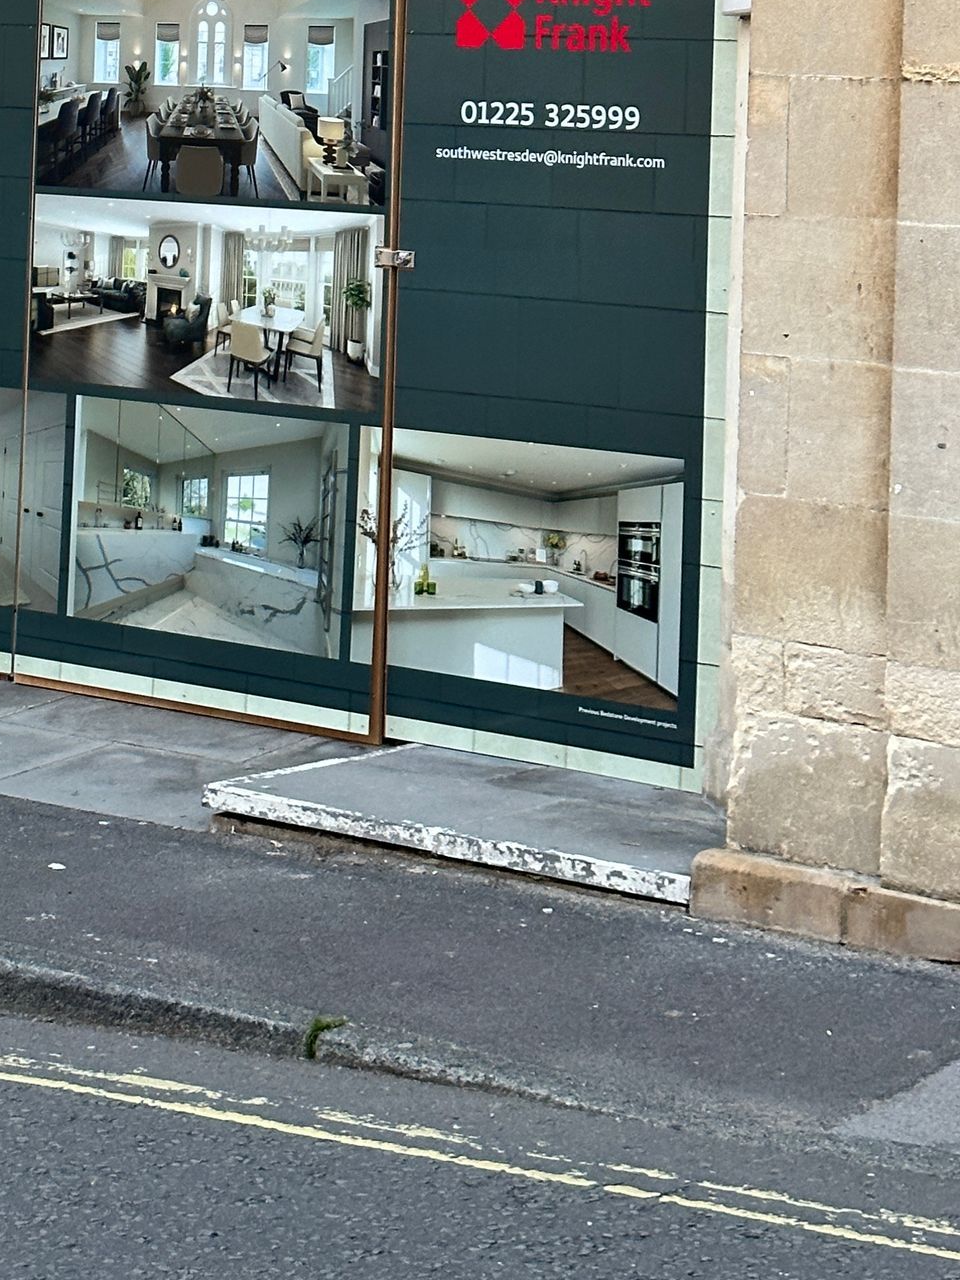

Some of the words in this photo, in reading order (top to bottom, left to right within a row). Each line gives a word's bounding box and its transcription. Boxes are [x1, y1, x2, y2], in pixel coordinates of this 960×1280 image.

[534, 15, 632, 52] Frank
[460, 100, 535, 126] 01225
[544, 103, 641, 130] 325999
[435, 145, 665, 169] southwestresdev@knightfrank.com
